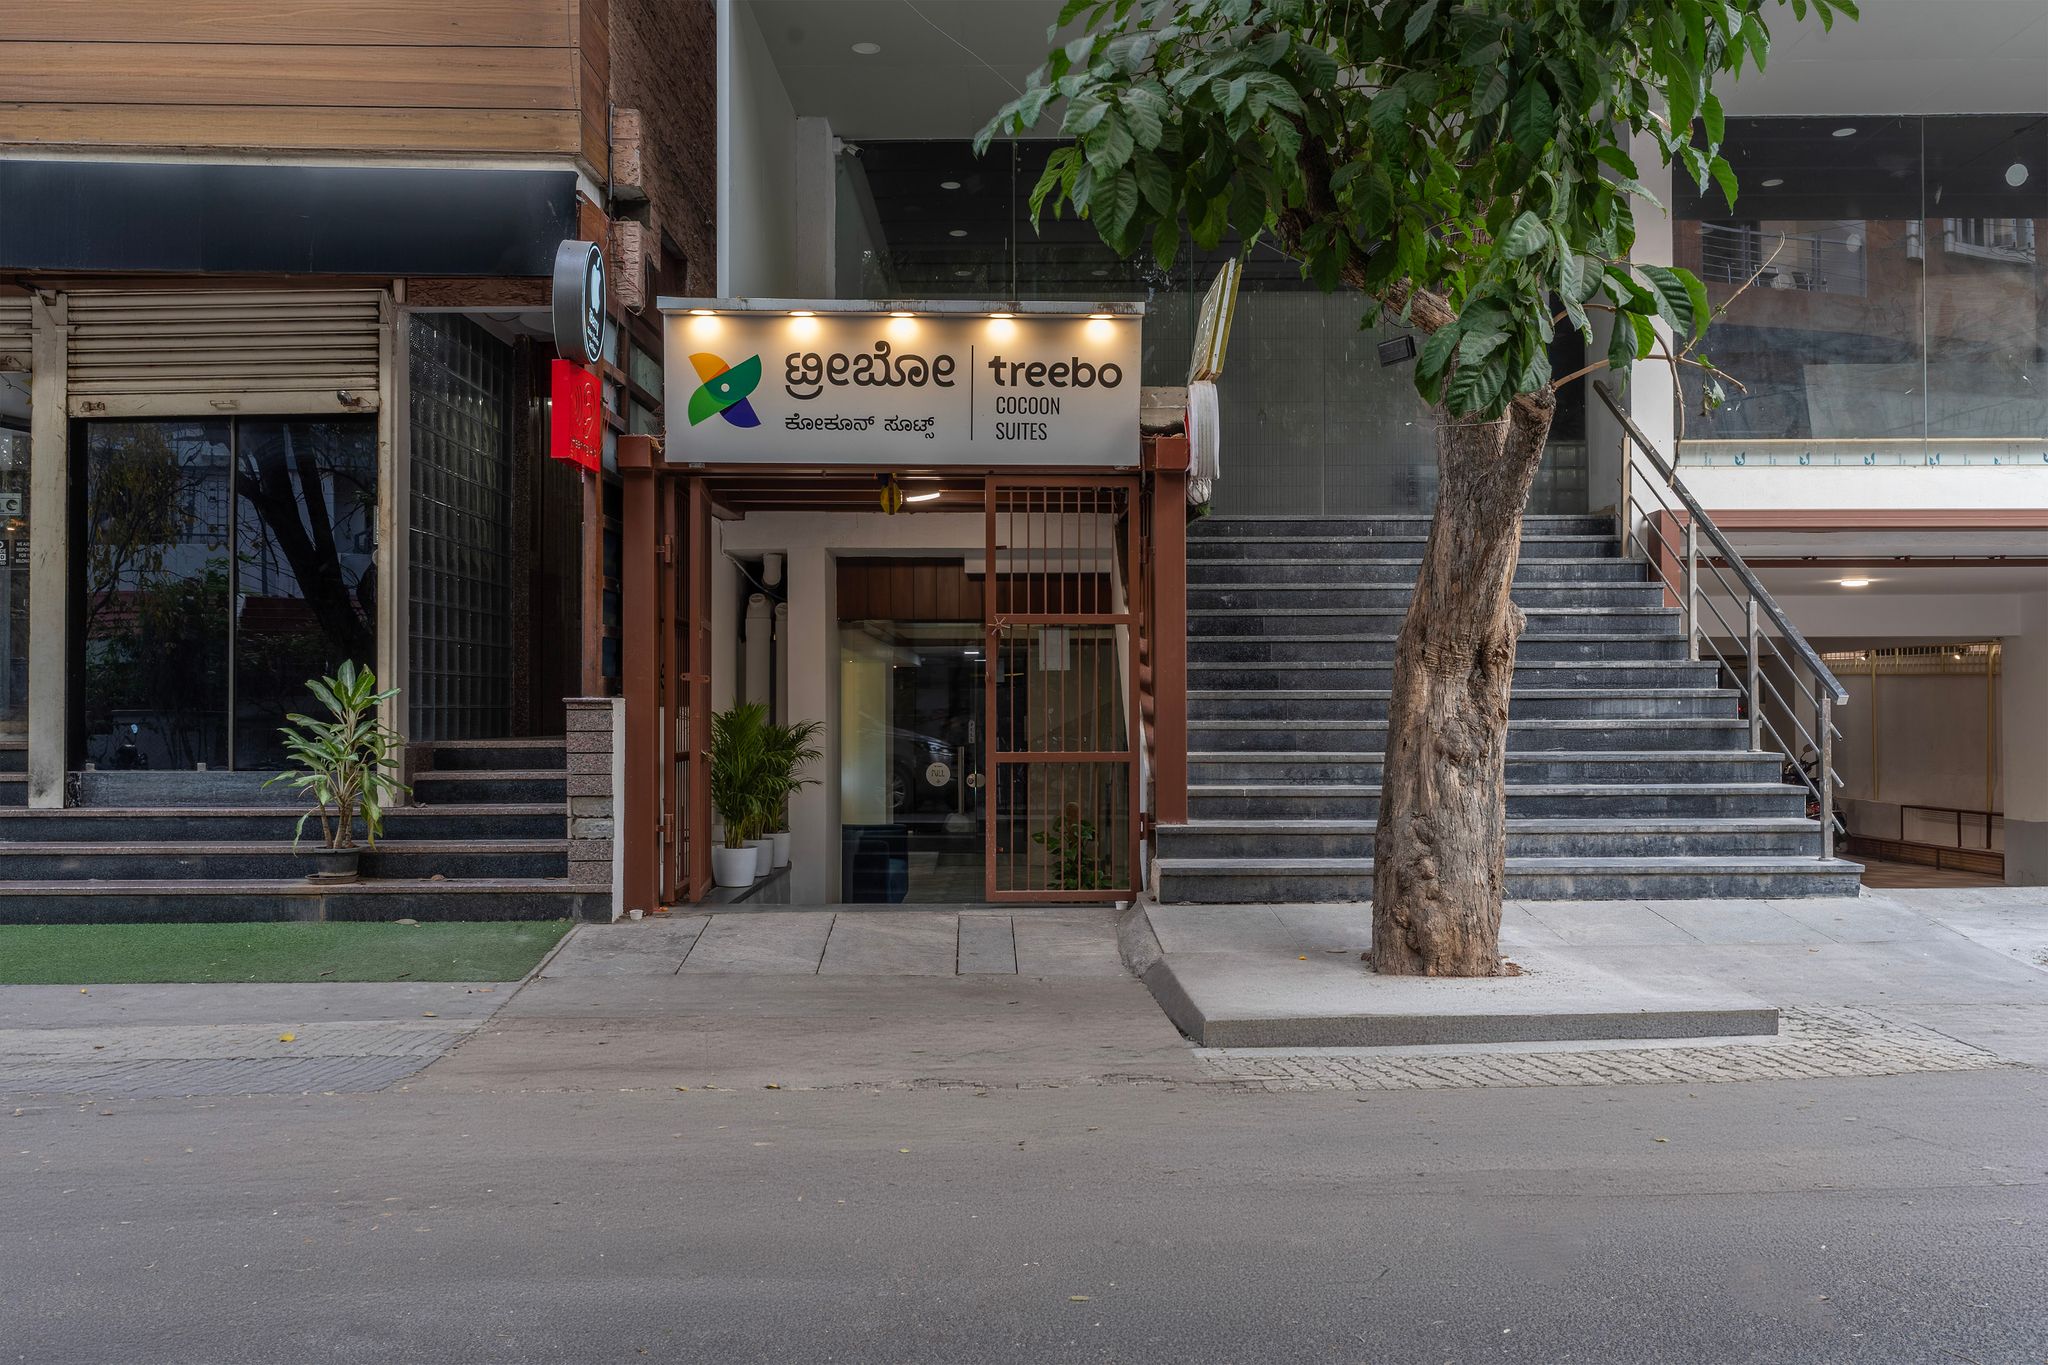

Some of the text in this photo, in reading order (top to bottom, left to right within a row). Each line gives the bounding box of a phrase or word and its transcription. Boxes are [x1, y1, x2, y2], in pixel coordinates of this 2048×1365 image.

[784, 340, 956, 400] ಟ್ರೀಬೋ
[988, 355, 1123, 388] treebo
[996, 396, 1060, 415] COCOON
[785, 412, 935, 439] ಕೋಕೂನ್ ಸೂಟ್ಸ್
[995, 422, 1048, 441] SUITES
